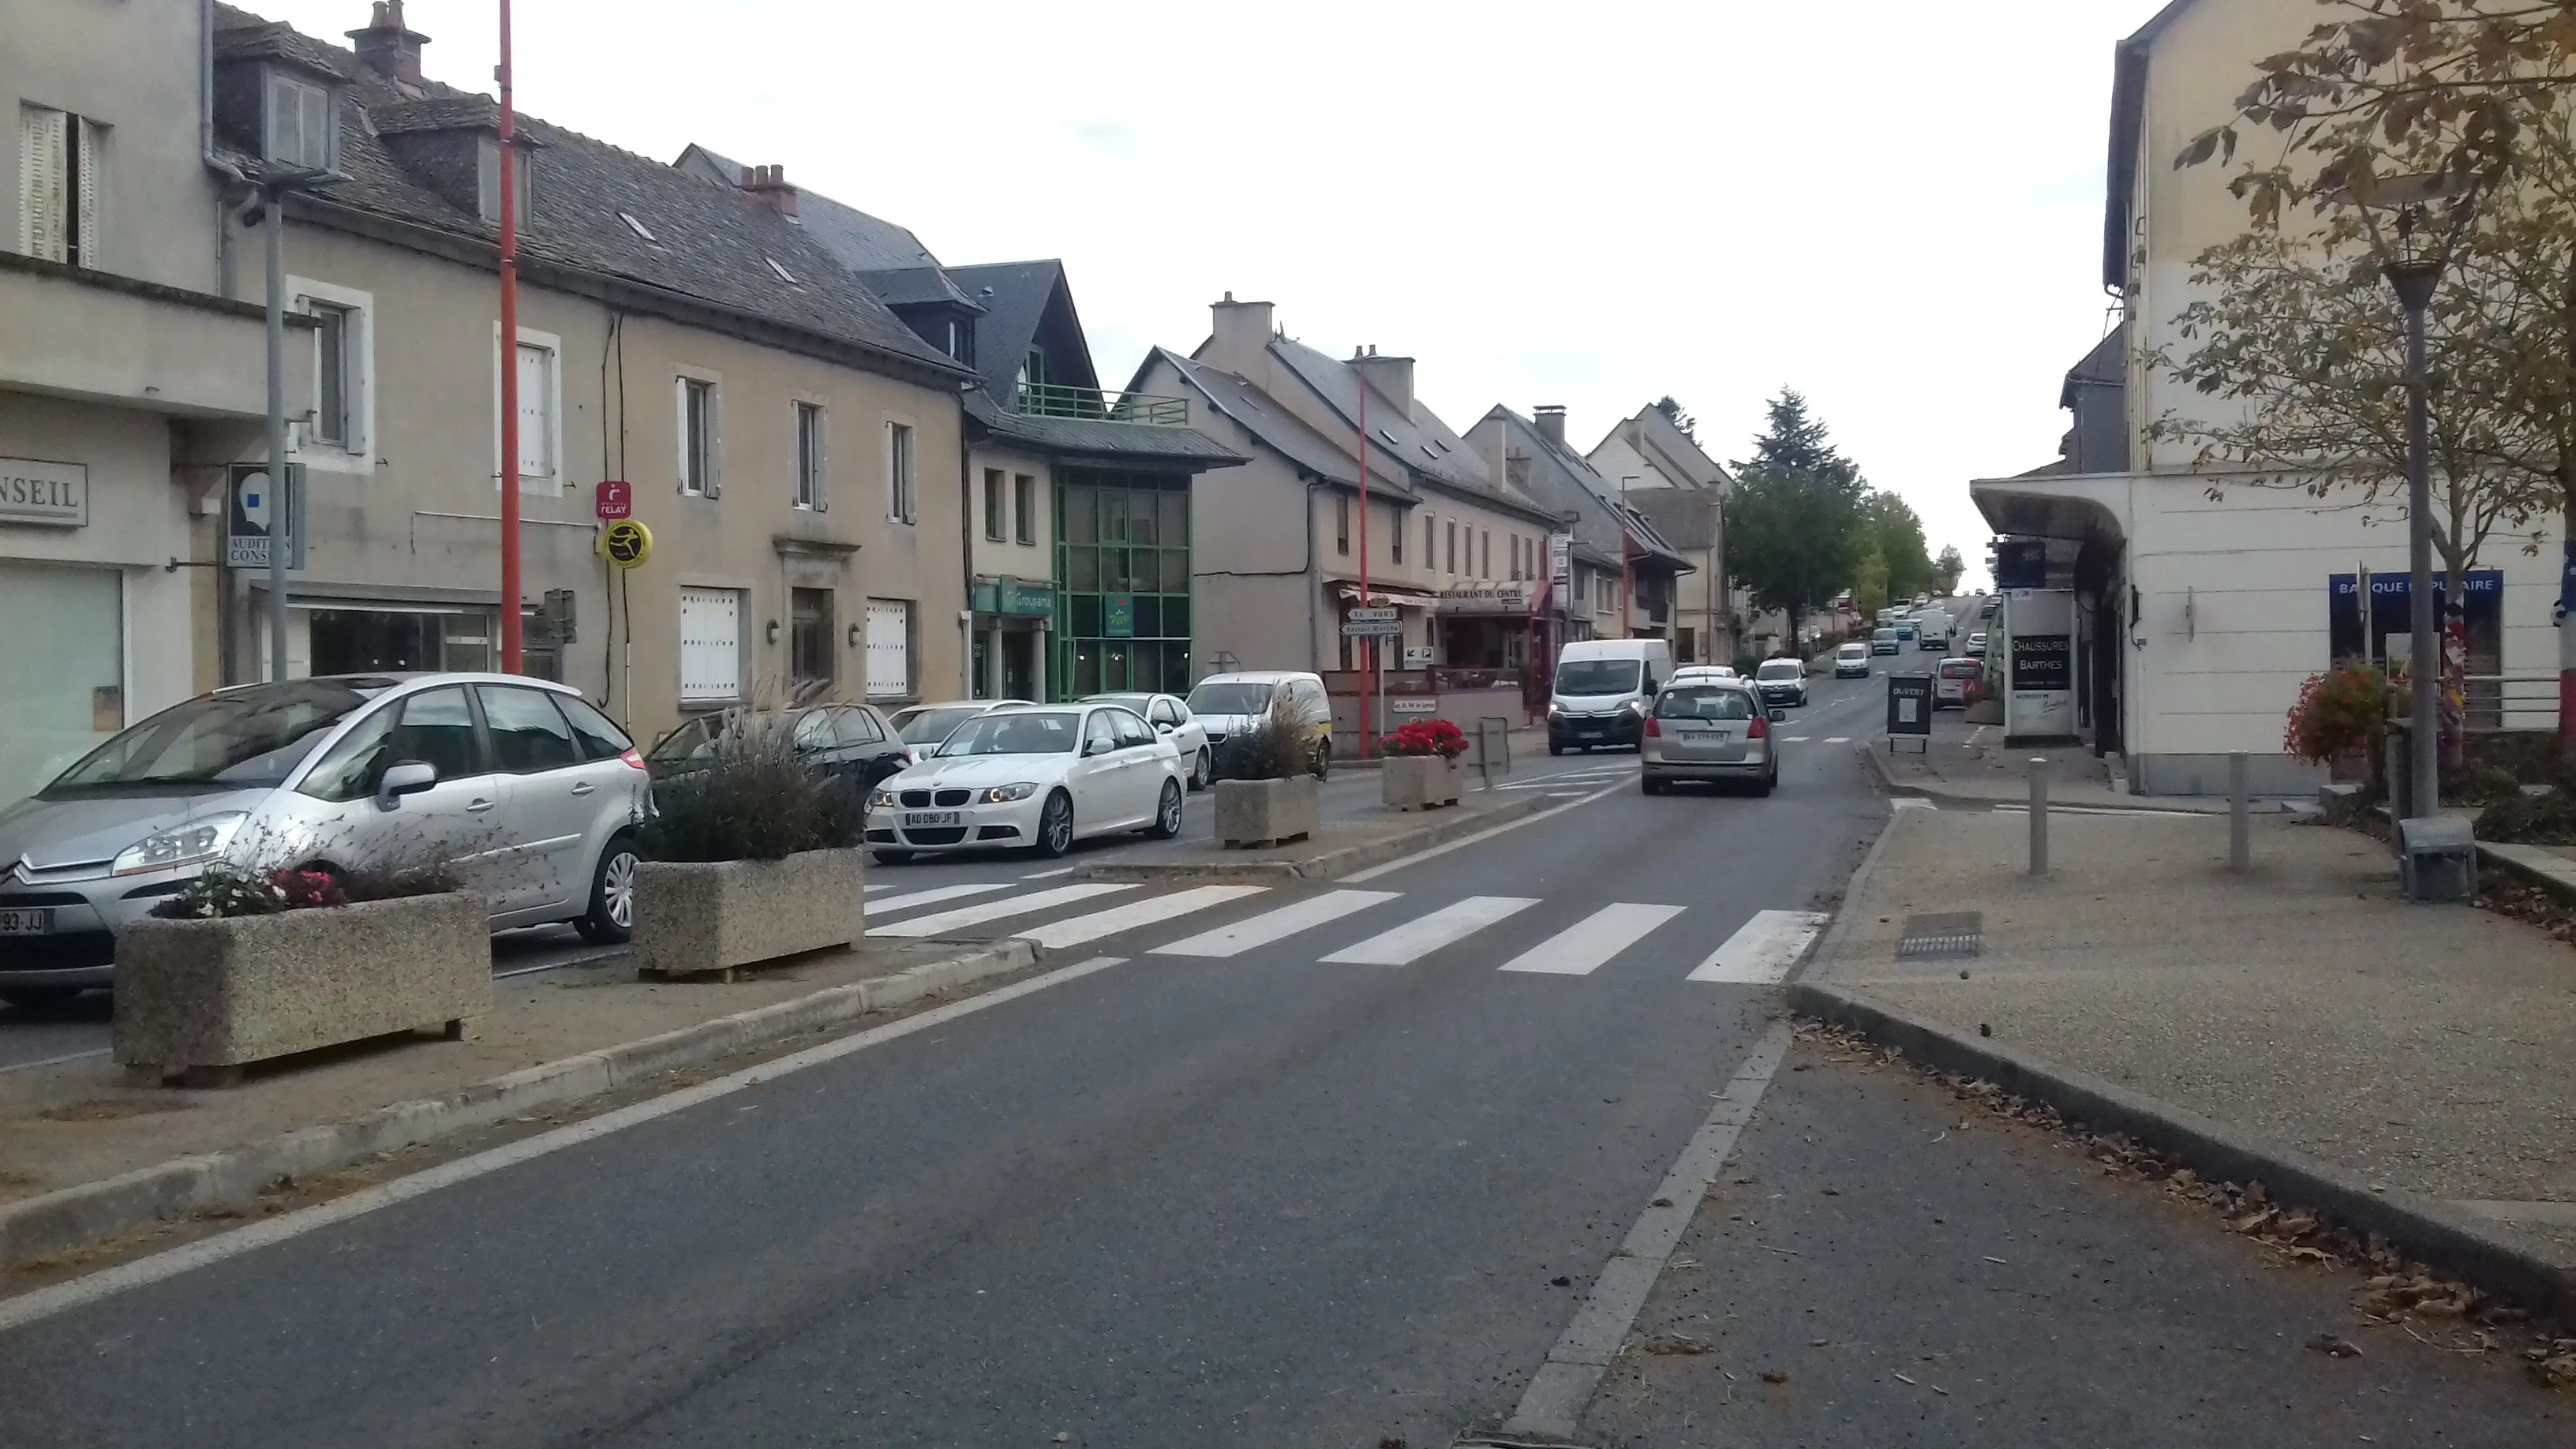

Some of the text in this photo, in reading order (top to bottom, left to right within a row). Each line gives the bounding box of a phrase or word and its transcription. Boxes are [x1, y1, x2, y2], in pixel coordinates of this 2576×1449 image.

[2340, 579, 2494, 593] BAQUE PUAIRE
[1440, 590, 1522, 599] RESTAURANT DU CENTRE
[2012, 640, 2069, 652] CHAUSSURES
[2020, 660, 2062, 670] BARTHES
